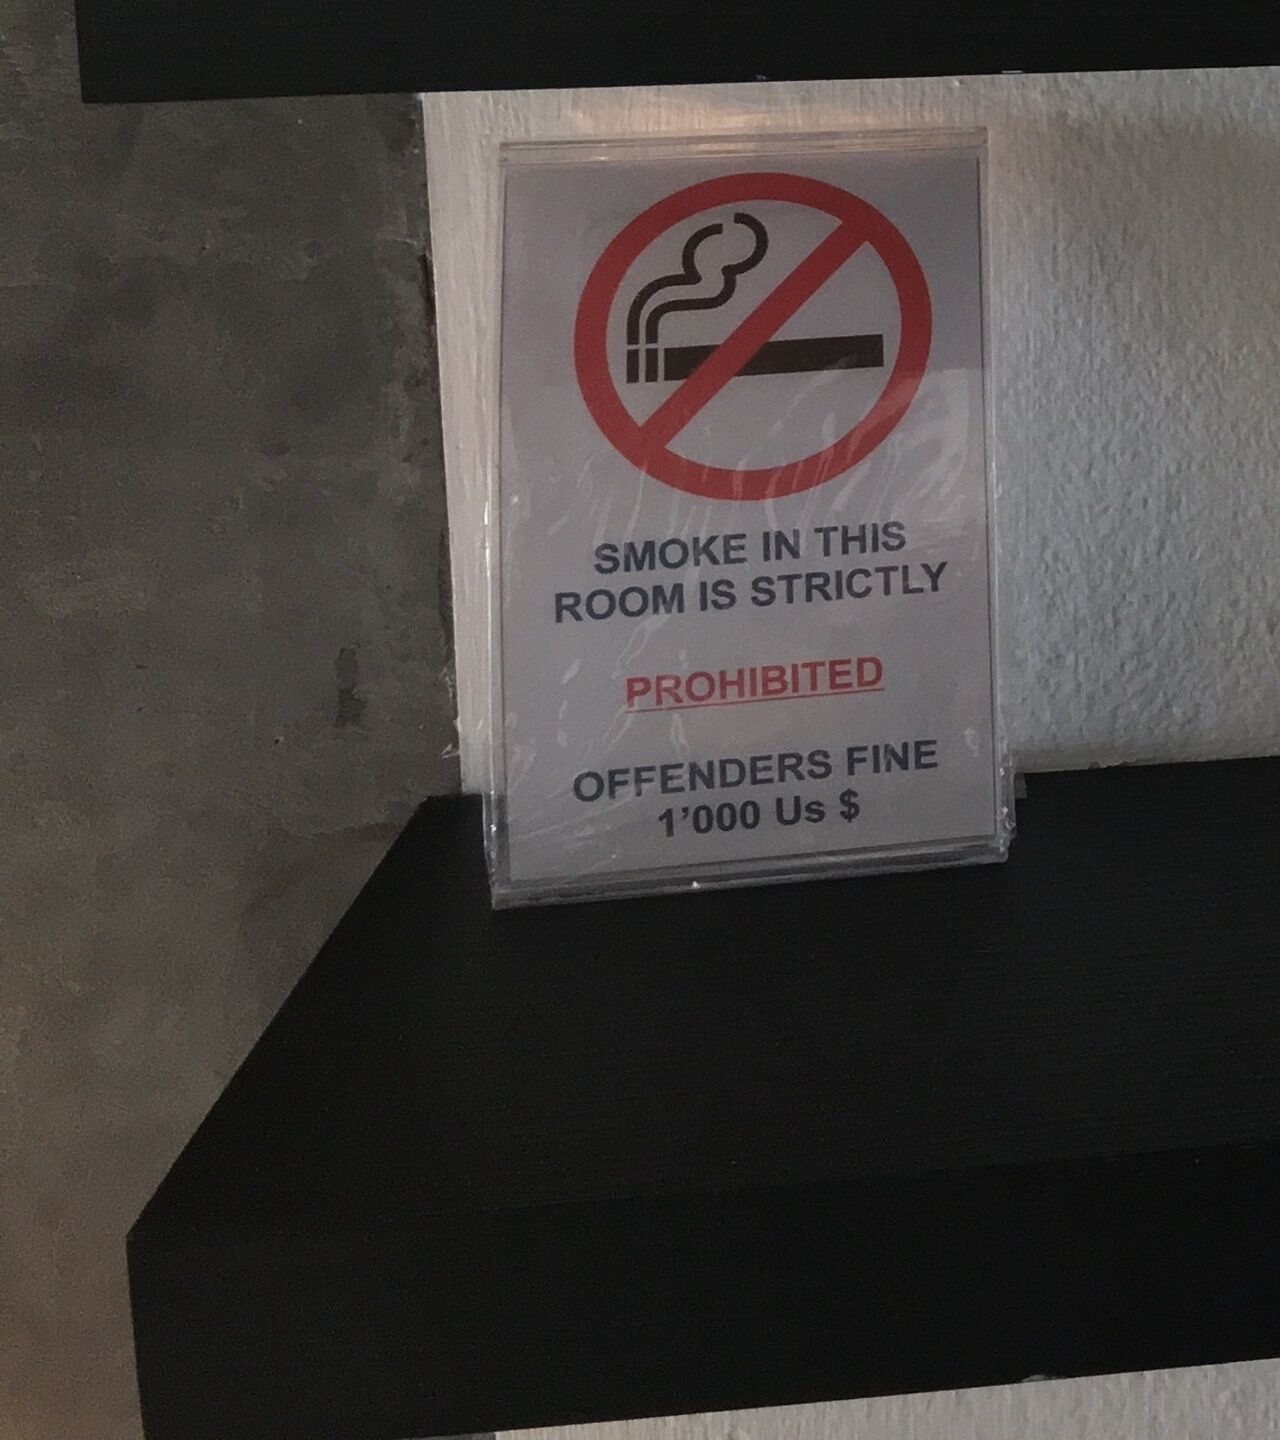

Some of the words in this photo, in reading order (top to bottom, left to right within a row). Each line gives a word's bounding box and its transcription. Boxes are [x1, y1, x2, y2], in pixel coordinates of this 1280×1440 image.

[593, 532, 747, 575] SMOKE
[762, 528, 802, 562] IN
[814, 521, 907, 558] THIS
[554, 580, 685, 623] ROOM
[698, 578, 738, 612] IS
[750, 561, 949, 607] STRICTLY
[625, 656, 884, 709] PROHIBITED
[572, 748, 833, 803] OFFENDERS
[846, 739, 939, 776] FINE
[658, 800, 761, 838] 1'000
[775, 794, 826, 827] Us
[838, 788, 861, 822] $
